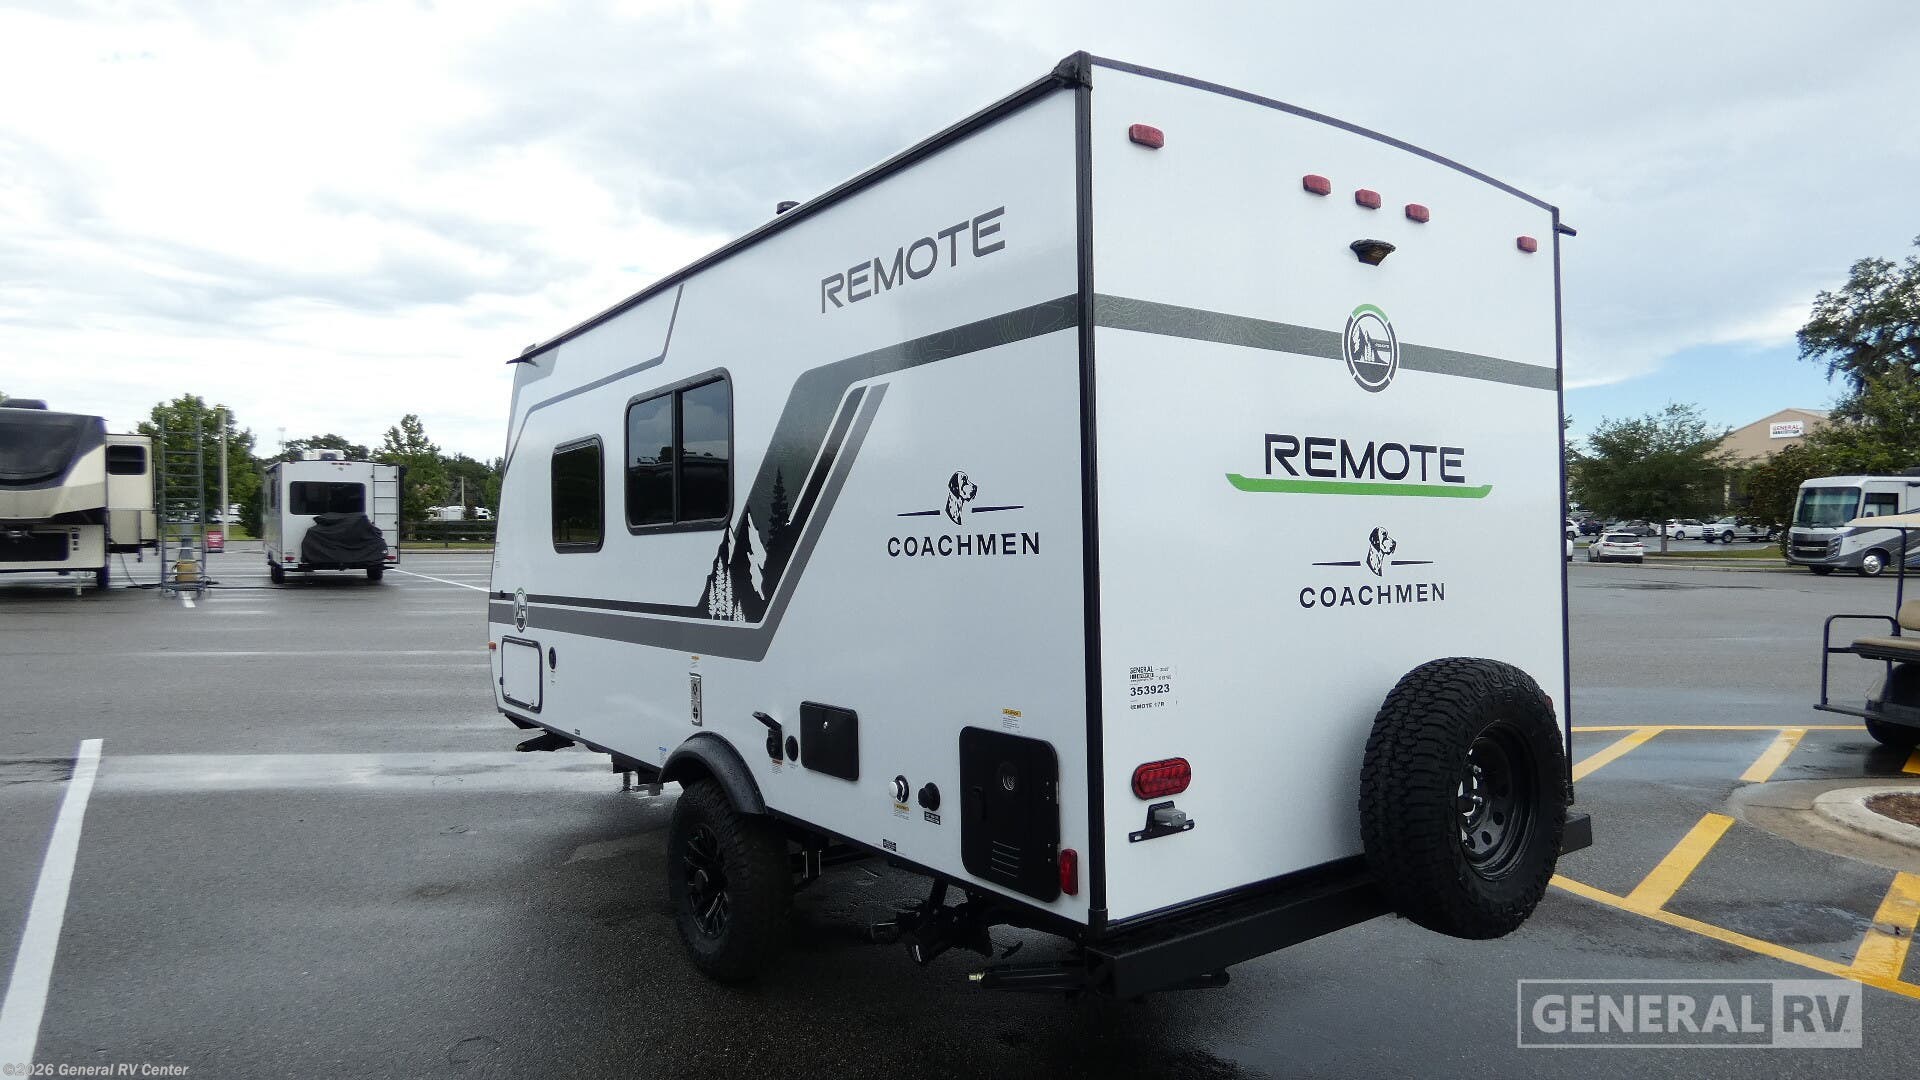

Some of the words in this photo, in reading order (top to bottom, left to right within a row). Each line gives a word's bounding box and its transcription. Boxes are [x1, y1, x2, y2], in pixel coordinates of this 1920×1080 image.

[821, 205, 1006, 314] REMOTE
[1264, 433, 1466, 483] REMOTE
[887, 531, 1040, 557] COACHMEN
[1299, 582, 1446, 608] COACHMEN
[1130, 683, 1170, 697] 353923
